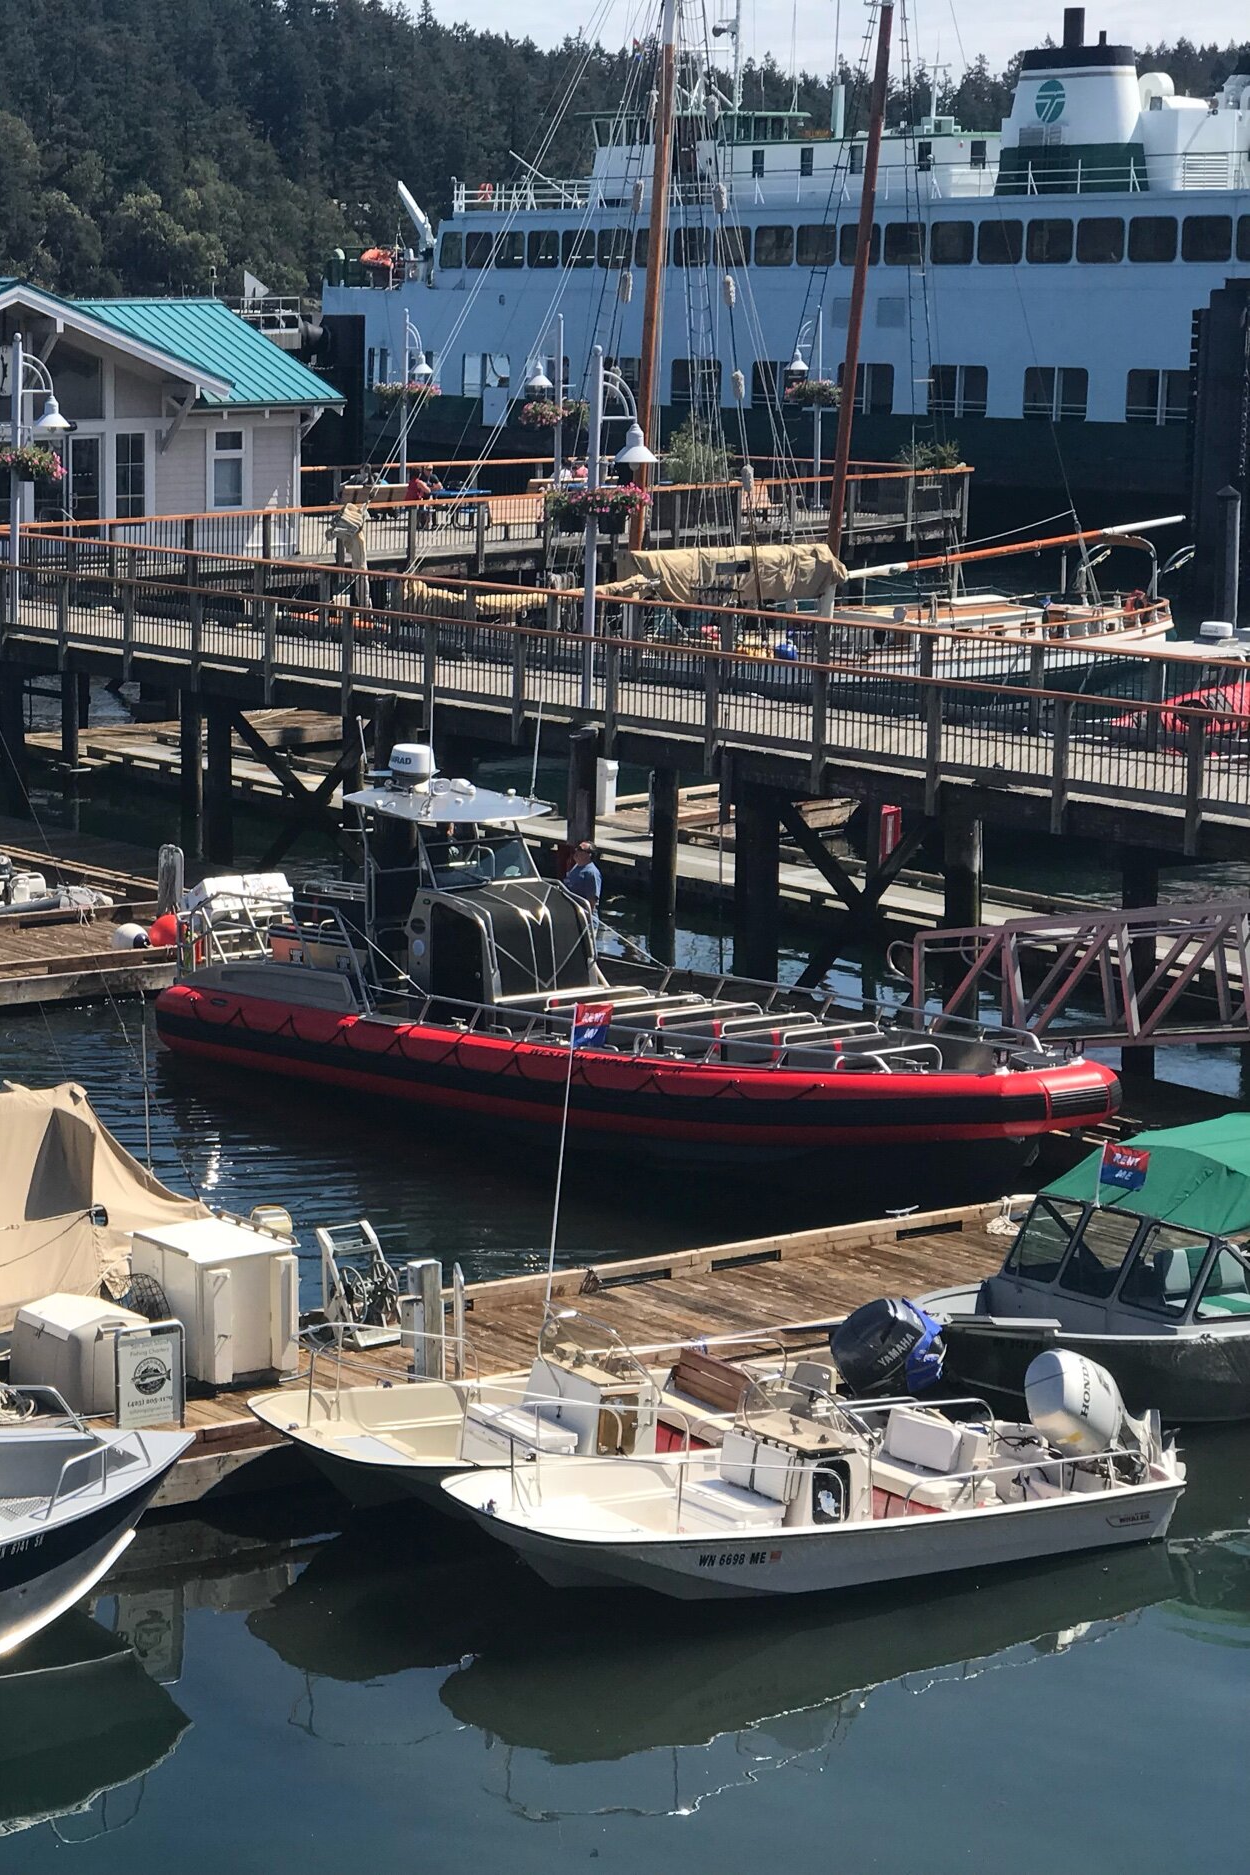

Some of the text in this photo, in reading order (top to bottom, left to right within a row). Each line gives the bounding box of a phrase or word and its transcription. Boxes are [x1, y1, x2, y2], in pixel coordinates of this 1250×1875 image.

[1112, 1152, 1141, 1167] RENT
[1114, 1169, 1133, 1181] ME
[877, 1332, 916, 1367] YAMAHA
[1078, 1357, 1092, 1419] HONDA
[699, 1551, 767, 1567] WN 6698 ME
